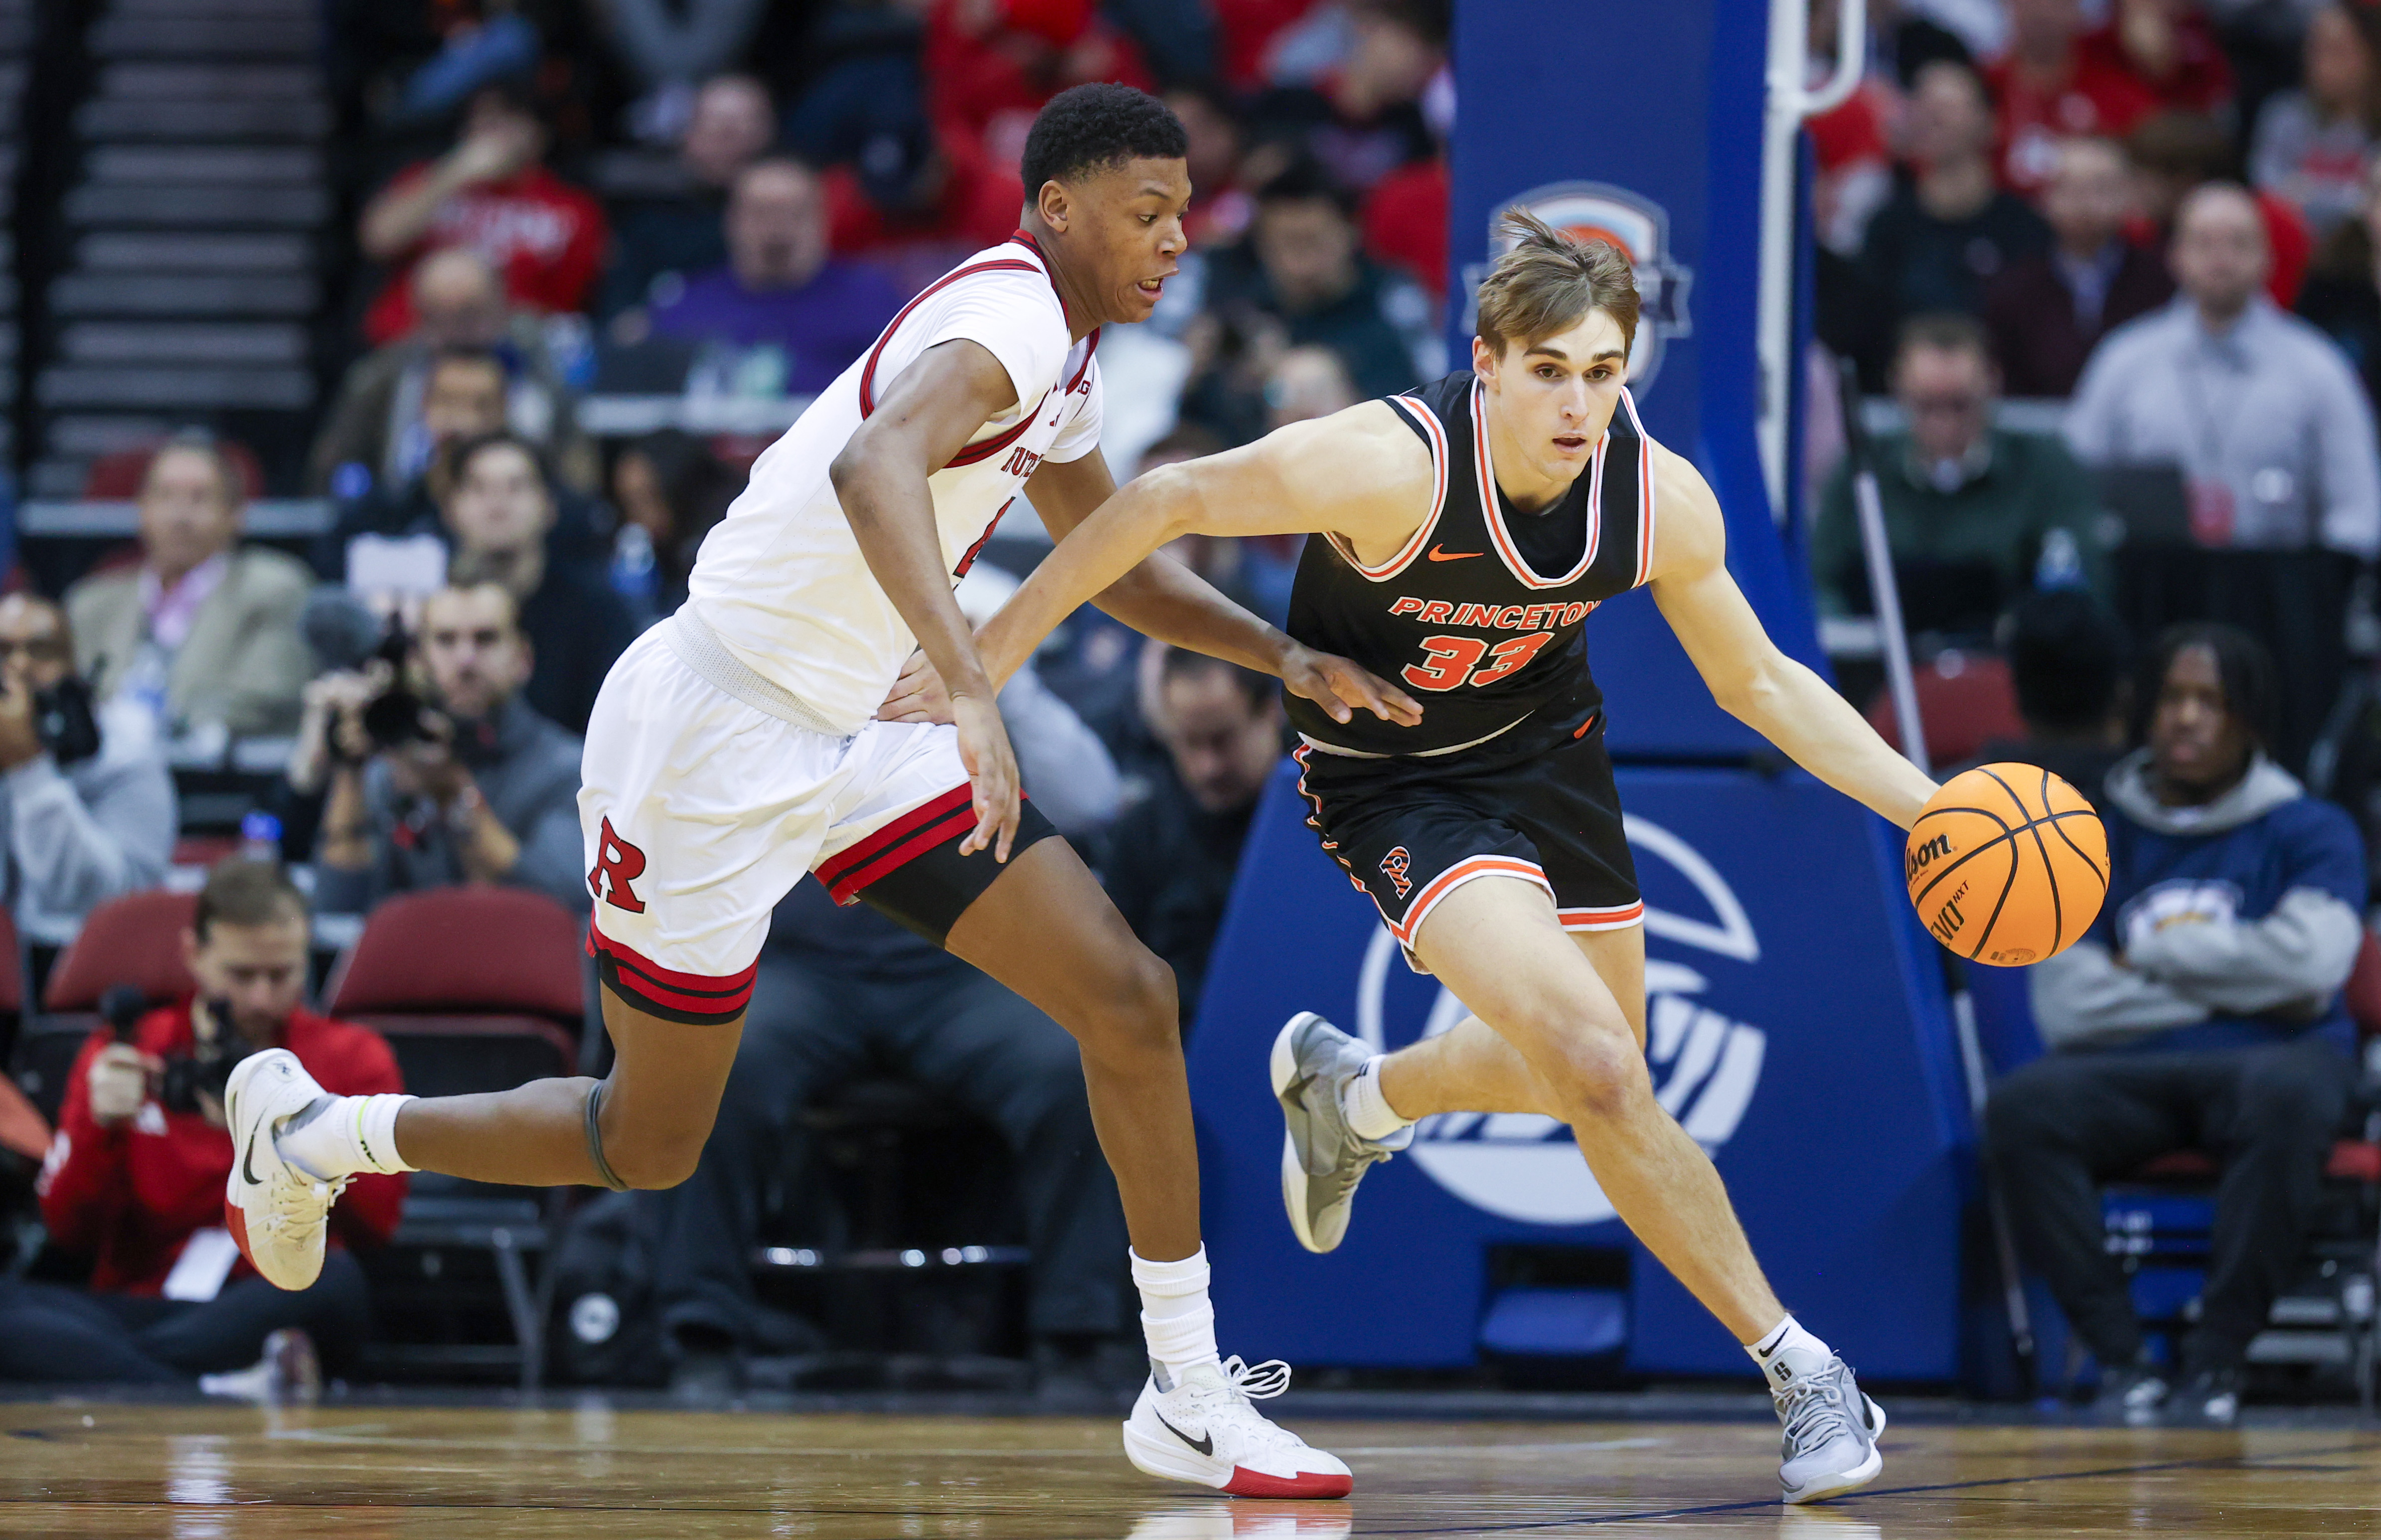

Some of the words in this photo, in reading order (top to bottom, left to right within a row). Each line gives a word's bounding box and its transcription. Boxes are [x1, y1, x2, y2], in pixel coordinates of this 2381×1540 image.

[1400, 632, 1555, 692] 33
[587, 814, 646, 915] R
[1379, 846, 1413, 900] P
[1953, 880, 1969, 904] NXT
